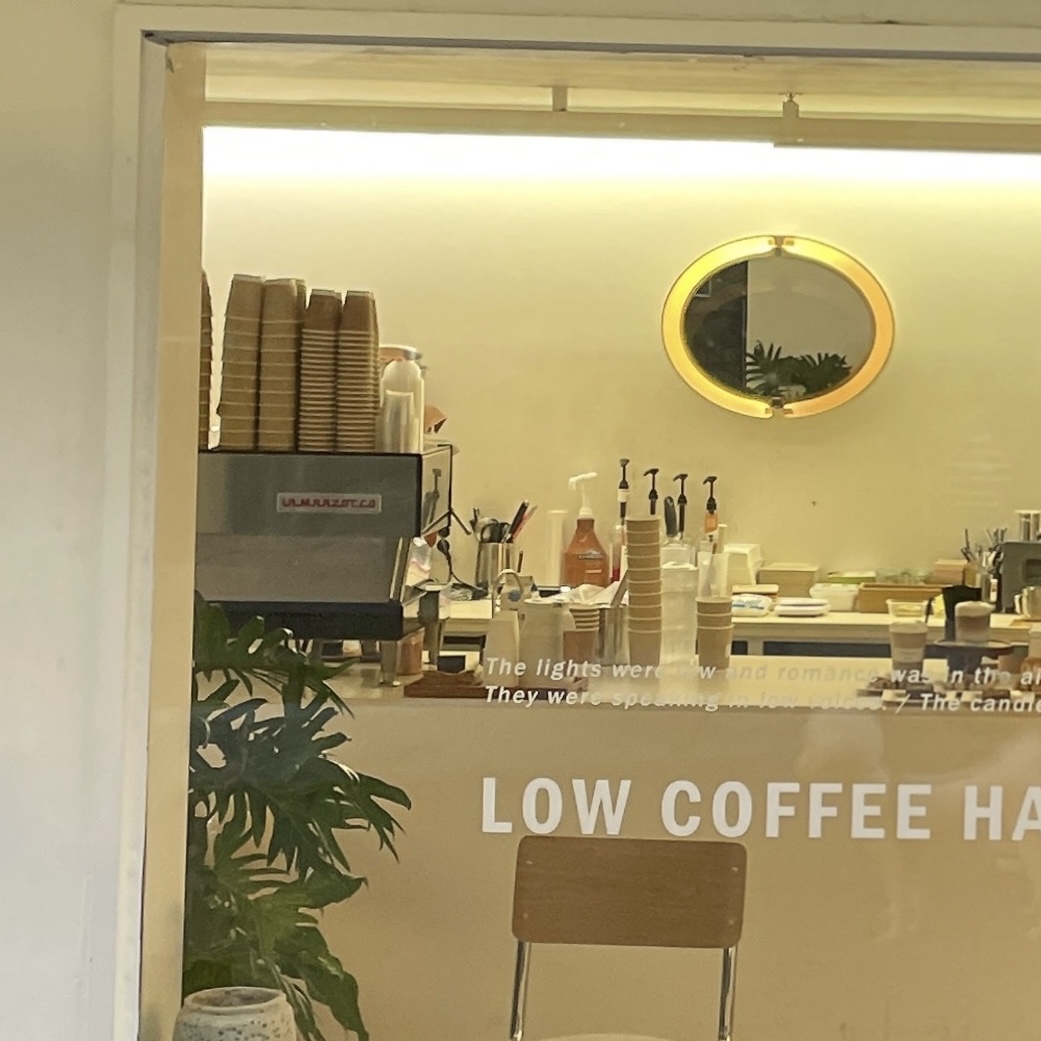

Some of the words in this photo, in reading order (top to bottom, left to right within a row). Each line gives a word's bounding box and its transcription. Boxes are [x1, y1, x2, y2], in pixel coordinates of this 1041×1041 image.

[486, 657, 527, 676] The
[536, 658, 602, 681] lights
[612, 664, 664, 679] were
[725, 664, 768, 680] and
[777, 667, 880, 683] romance
[975, 667, 1012, 685] the
[485, 685, 539, 708] They
[548, 689, 602, 706] were
[919, 693, 960, 711] The
[481, 777, 632, 835] LOW
[661, 780, 931, 840] COFFEE
